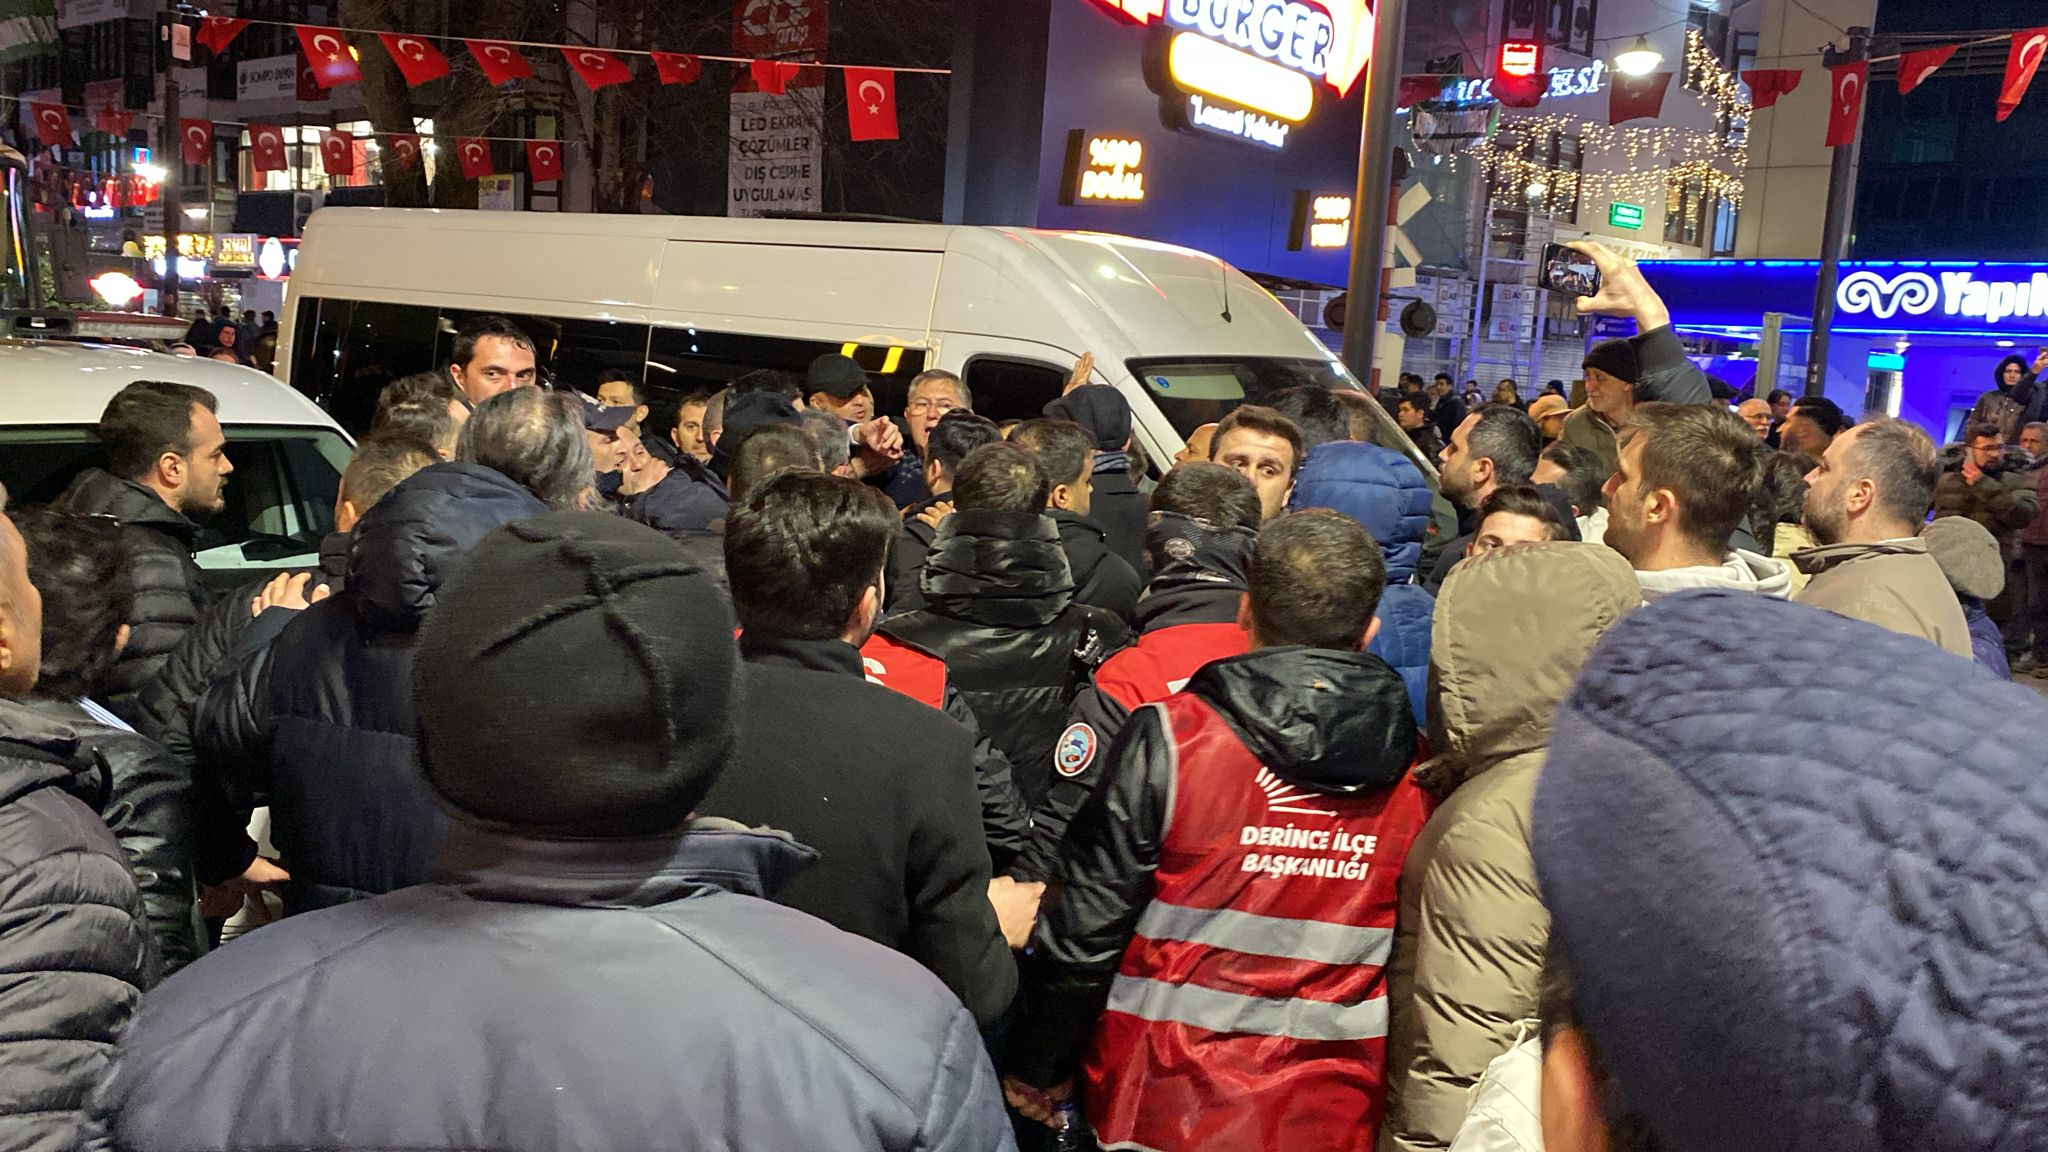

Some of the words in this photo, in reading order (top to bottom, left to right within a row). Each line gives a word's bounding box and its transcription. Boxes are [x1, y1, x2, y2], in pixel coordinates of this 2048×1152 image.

[741, 118, 766, 132] LED
[1239, 823, 1331, 850] DERİNCE
[1331, 828, 1378, 861] İLÇE
[1240, 853, 1370, 881] BAŞKANLIĞI
